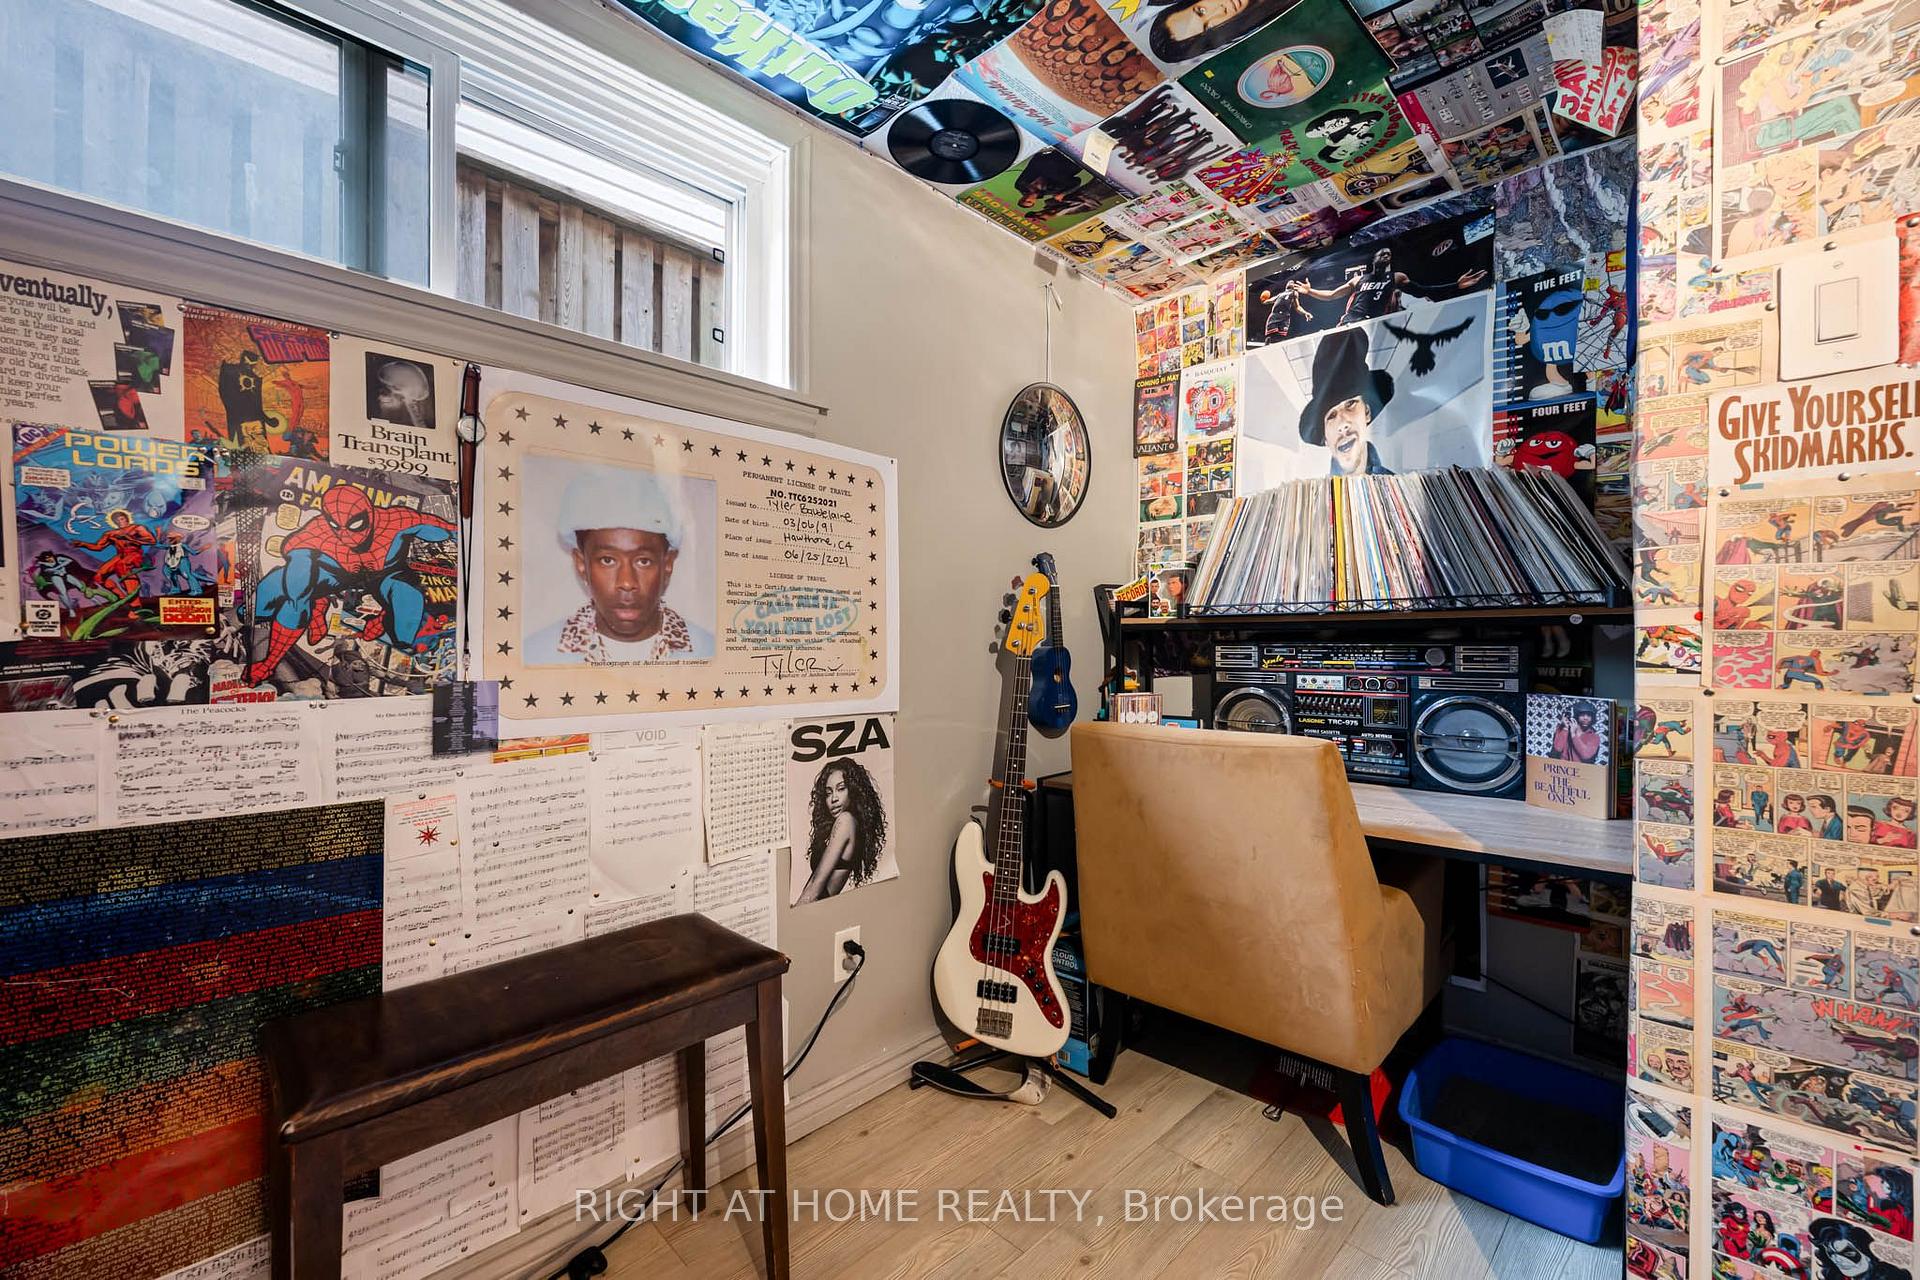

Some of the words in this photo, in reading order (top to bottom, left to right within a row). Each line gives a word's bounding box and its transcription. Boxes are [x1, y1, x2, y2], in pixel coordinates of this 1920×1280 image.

[1360, 280, 1391, 292] HEAT
[1534, 278, 1556, 292] FIVE
[1558, 269, 1583, 286] FEET
[1373, 291, 1382, 301] 3
[38, 300, 56, 312] will
[58, 304, 71, 315] be
[9, 307, 21, 316] to
[23, 308, 43, 321] buy
[47, 312, 74, 325] skins
[77, 318, 97, 330] and
[18, 320, 29, 328] at
[33, 320, 59, 333] their
[62, 325, 85, 337] local
[35, 331, 59, 345] they
[9, 356, 25, 368] old
[28, 360, 48, 373] bag
[50, 364, 62, 373] or
[30, 350, 50, 361] you
[53, 353, 81, 367] think
[8, 376, 33, 389] keep
[36, 381, 62, 393] your
[19, 370, 32, 379] or
[34, 370, 71, 384] divider
[1136, 377, 1160, 388] COMING
[1166, 373, 1180, 382] MAY
[24, 390, 62, 403] perfect
[1532, 404, 1561, 418] FOUR
[1563, 401, 1587, 414] FEET
[1717, 394, 1781, 441] GIVE
[21, 427, 42, 442] DC
[371, 424, 428, 447] Brain
[64, 432, 206, 462] POWER
[337, 432, 457, 466] Transplant,
[1136, 443, 1169, 454] VALIANT
[1733, 420, 1914, 486] SKIDMARKS.
[72, 450, 200, 477] LORDS
[367, 456, 430, 478] $39.99.
[742, 470, 784, 485] PERMANENT
[786, 478, 816, 491] LICENSE
[830, 487, 853, 497] TRAVEL
[725, 499, 748, 509] Issued
[766, 496, 796, 512] Tyler
[770, 488, 787, 500] NO.
[788, 492, 837, 508] TTC6252021
[725, 516, 740, 524] Date
[751, 519, 770, 528] birth
[783, 517, 834, 533] 03/06/91
[725, 533, 743, 542] Place
[754, 536, 772, 545] issue
[838, 539, 854, 551] CA
[724, 550, 739, 559] Date
[751, 553, 769, 561] issue
[784, 549, 849, 567] 06/25/2021
[769, 572, 794, 581] LICENSE
[726, 589, 757, 598] described
[727, 580, 741, 588] This
[764, 583, 787, 593] Certify
[1116, 582, 1149, 601] RECORDS
[814, 606, 851, 631] LOST
[222, 672, 239, 680] THE
[1559, 667, 1584, 678] FEET
[202, 706, 247, 715] Peacocks
[1298, 717, 1325, 725] LASONIC
[1328, 718, 1359, 727] TRC-975
[636, 729, 667, 742] VOID
[788, 717, 892, 763] SZA
[1543, 762, 1580, 778] PRINCE
[1551, 775, 1571, 787] THE
[1534, 780, 1590, 801] BEAUTIFUL
[1548, 793, 1575, 806] ONES
[97, 883, 138, 893] TALKING
[113, 876, 146, 885] HOLES
[110, 888, 145, 897] SOUND
